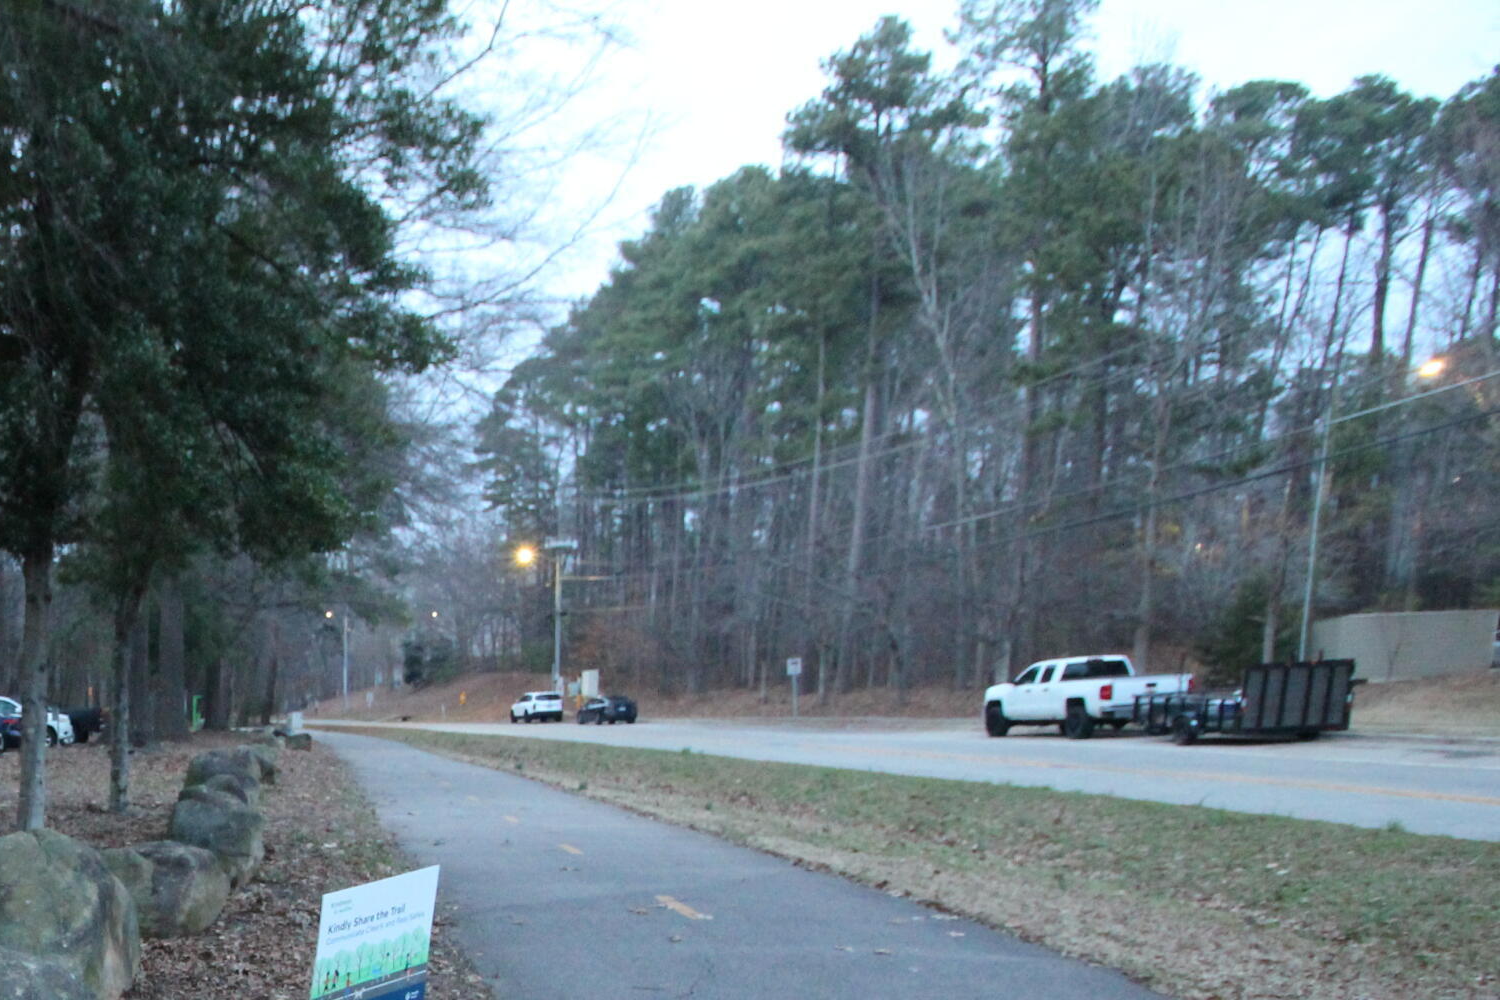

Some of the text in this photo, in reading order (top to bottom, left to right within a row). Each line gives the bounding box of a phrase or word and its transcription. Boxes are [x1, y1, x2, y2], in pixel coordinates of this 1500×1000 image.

[328, 904, 406, 934] Kindly Share the Trail
